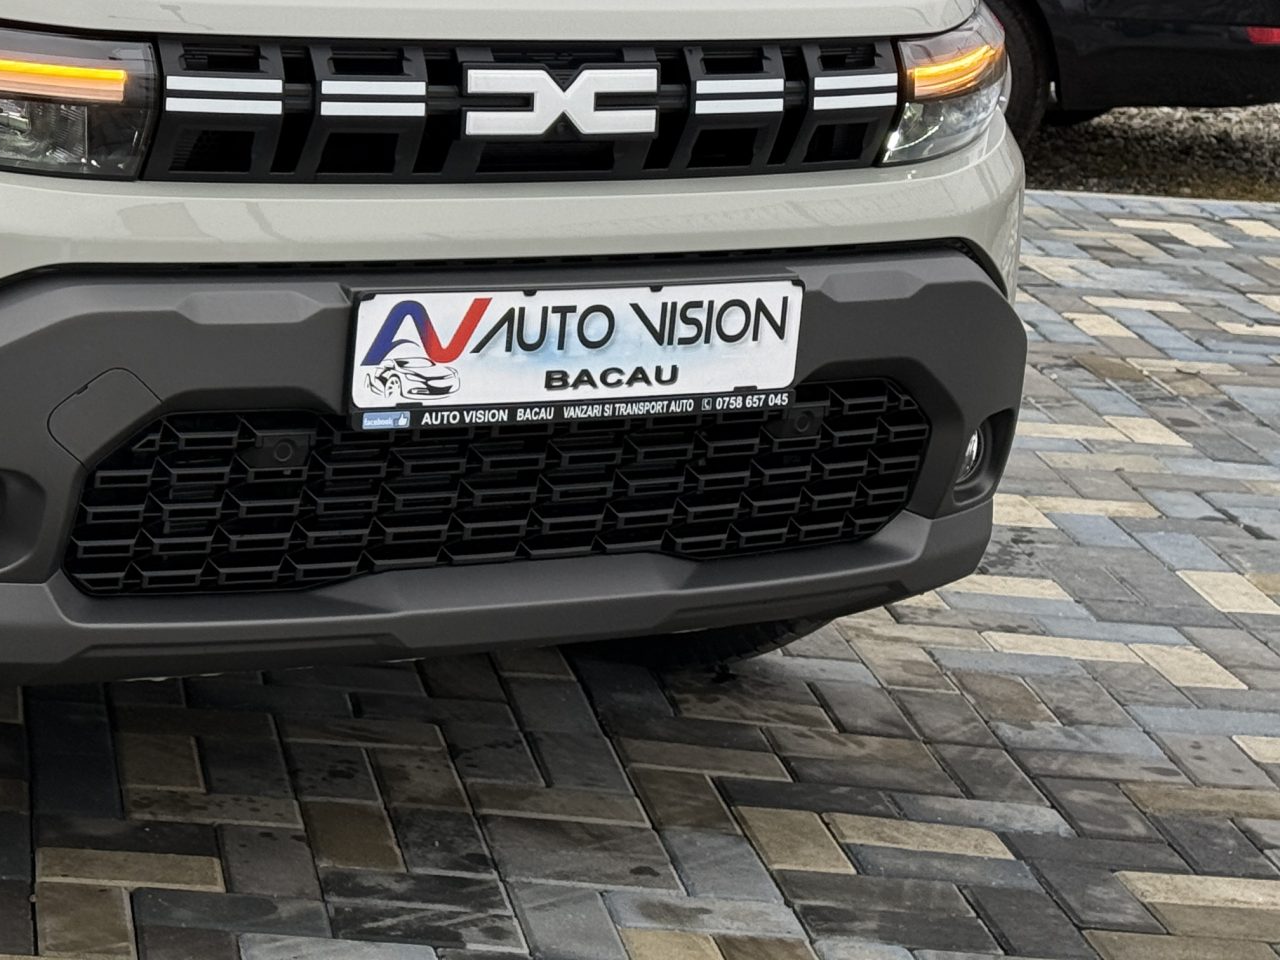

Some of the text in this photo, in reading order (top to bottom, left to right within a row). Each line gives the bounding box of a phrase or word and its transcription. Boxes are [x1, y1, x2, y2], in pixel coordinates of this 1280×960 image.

[470, 304, 616, 354] AUTO
[630, 295, 789, 347] VISION
[544, 365, 681, 390] BACAU
[421, 393, 789, 425] AUTO VISION BACAU VANZARI SI TRANSPORT AUTO 0758 657 045
